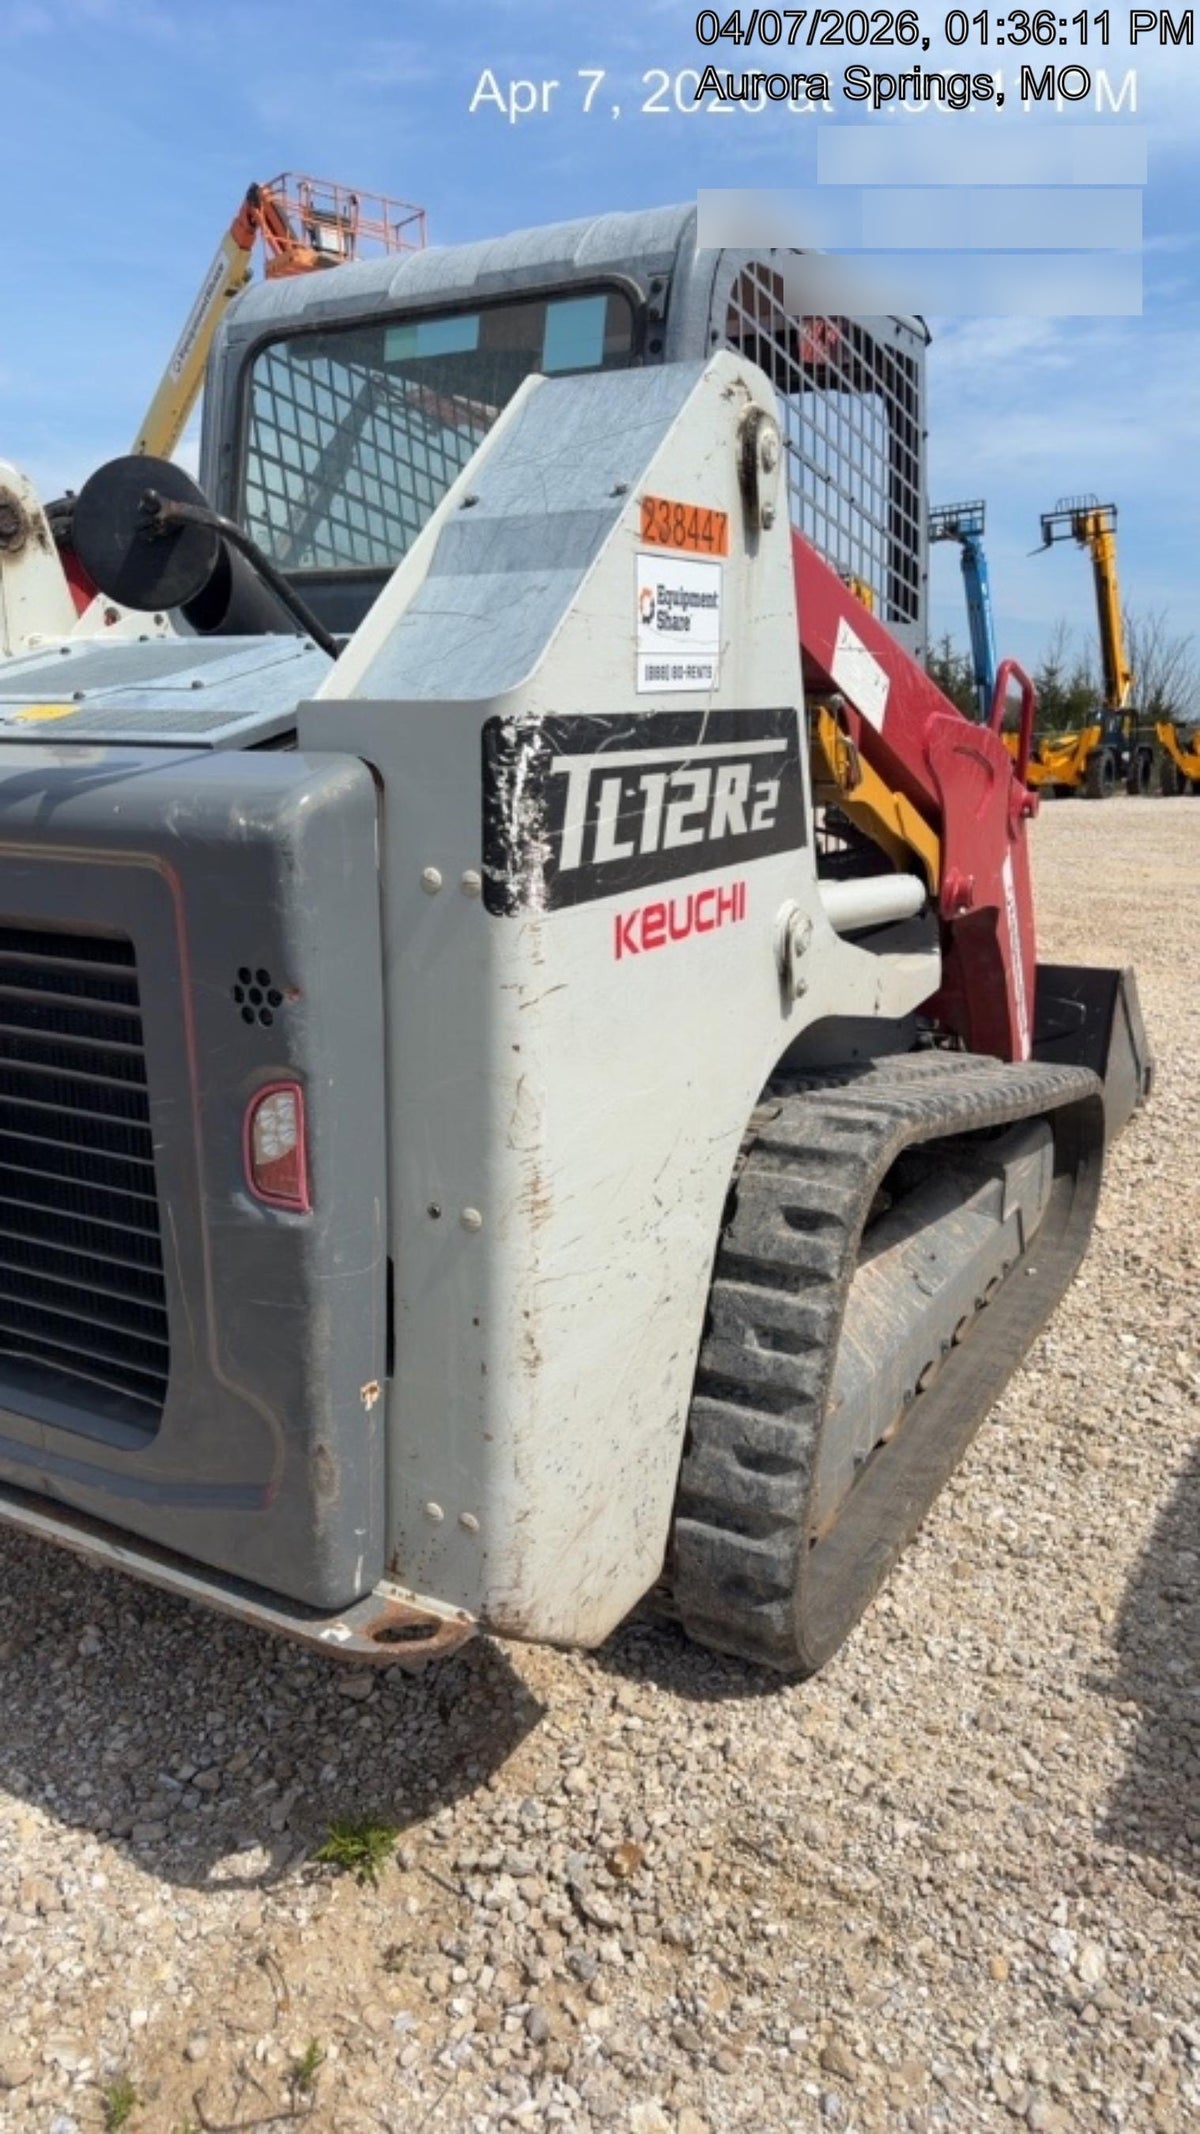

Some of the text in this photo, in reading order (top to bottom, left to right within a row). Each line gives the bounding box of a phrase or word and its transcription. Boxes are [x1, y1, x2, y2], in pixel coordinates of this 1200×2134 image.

[642, 497, 729, 553] 238447
[656, 583, 720, 612] Equipment
[656, 610, 691, 631] Share
